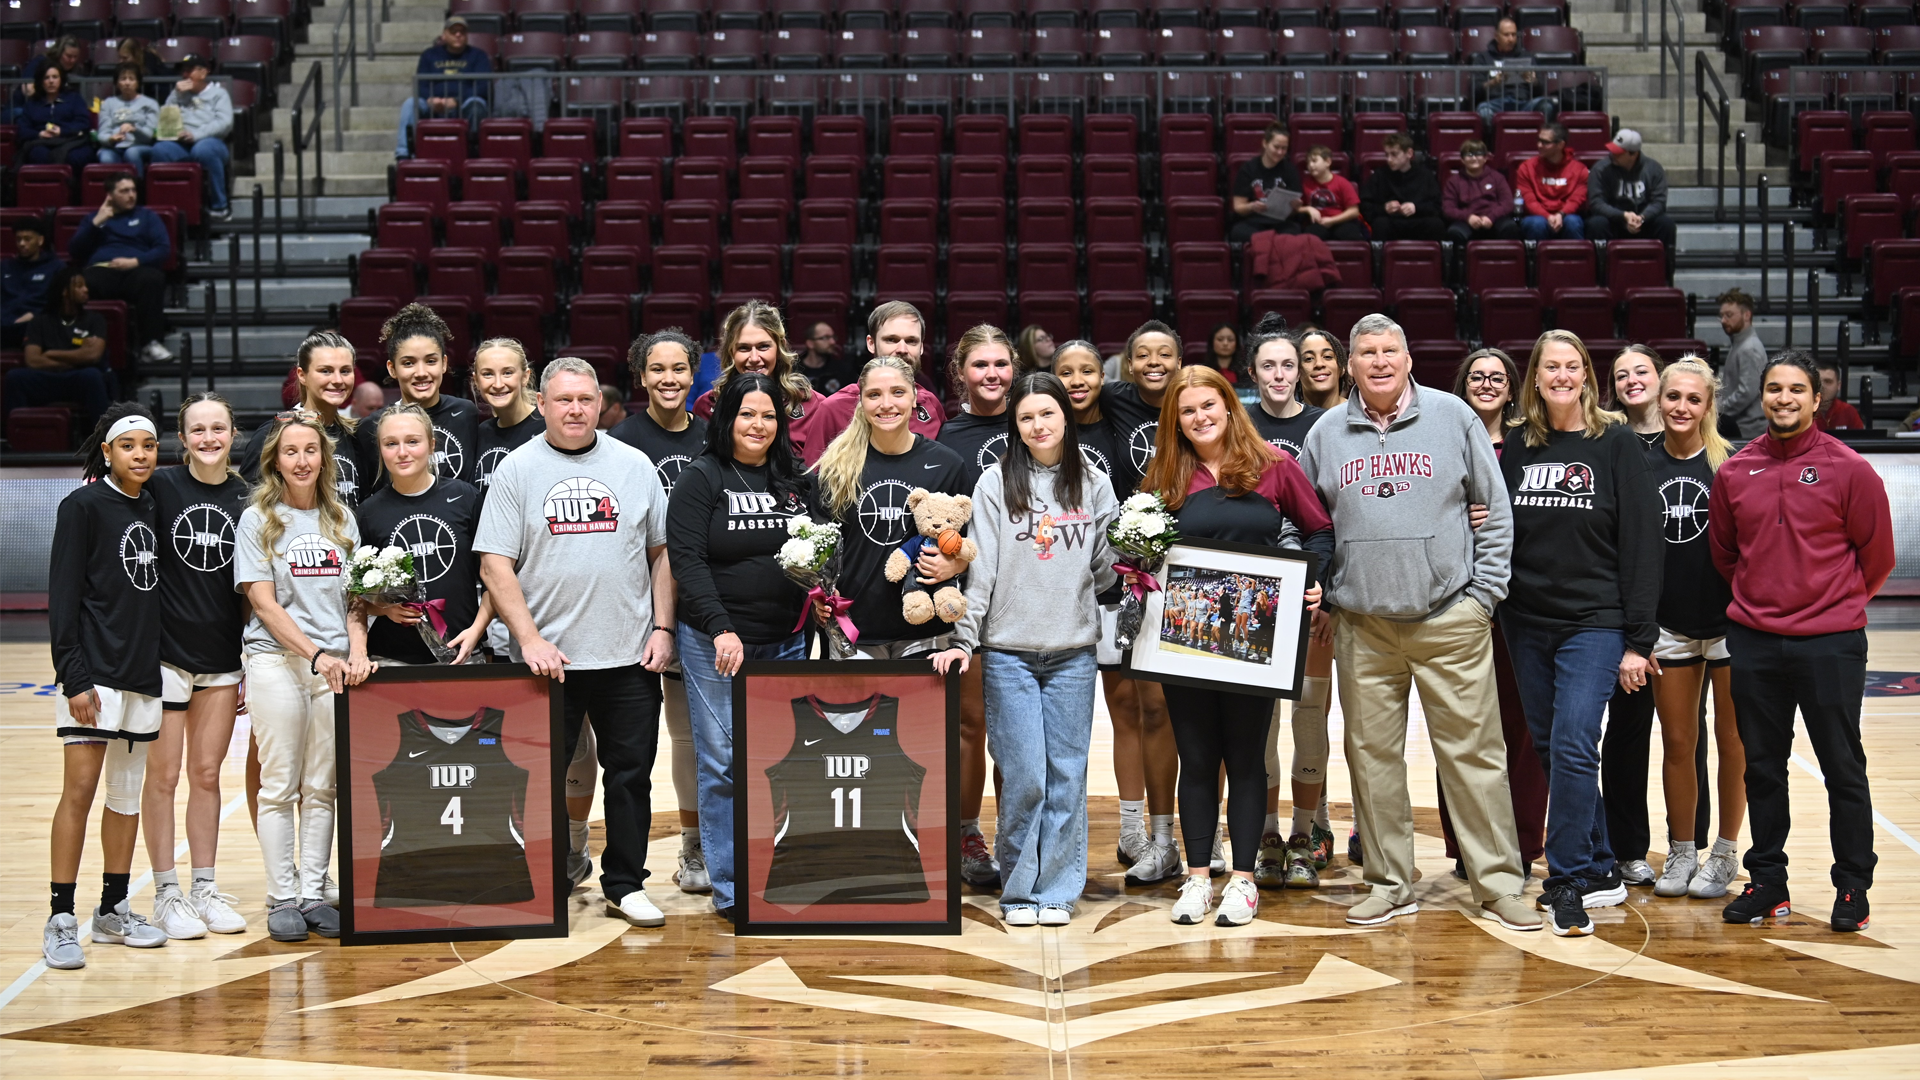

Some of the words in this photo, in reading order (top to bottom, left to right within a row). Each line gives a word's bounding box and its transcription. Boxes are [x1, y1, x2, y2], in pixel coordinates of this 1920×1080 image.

[1340, 457, 1365, 491] IUP
[1369, 452, 1434, 479] HAWKS
[1519, 464, 1567, 490] IUP
[1363, 486, 1374, 495] 18
[1397, 483, 1409, 491] 75
[728, 491, 778, 514] IUP
[1513, 495, 1594, 510] BASKETBALL
[879, 506, 903, 521] IUP
[1053, 512, 1090, 522] wilkerson
[1669, 504, 1693, 519] IUP
[553, 522, 588, 533] CRIMSON
[588, 521, 616, 531] HAWKS
[727, 518, 792, 531] BASKET
[195, 531, 219, 547] IUP
[411, 541, 435, 557] IUP
[294, 567, 319, 576] CRIMSON
[320, 567, 340, 575] HAWKS
[824, 755, 871, 779] IUP
[429, 764, 476, 789] IUP
[831, 787, 861, 828] 11
[440, 796, 465, 835] 4
